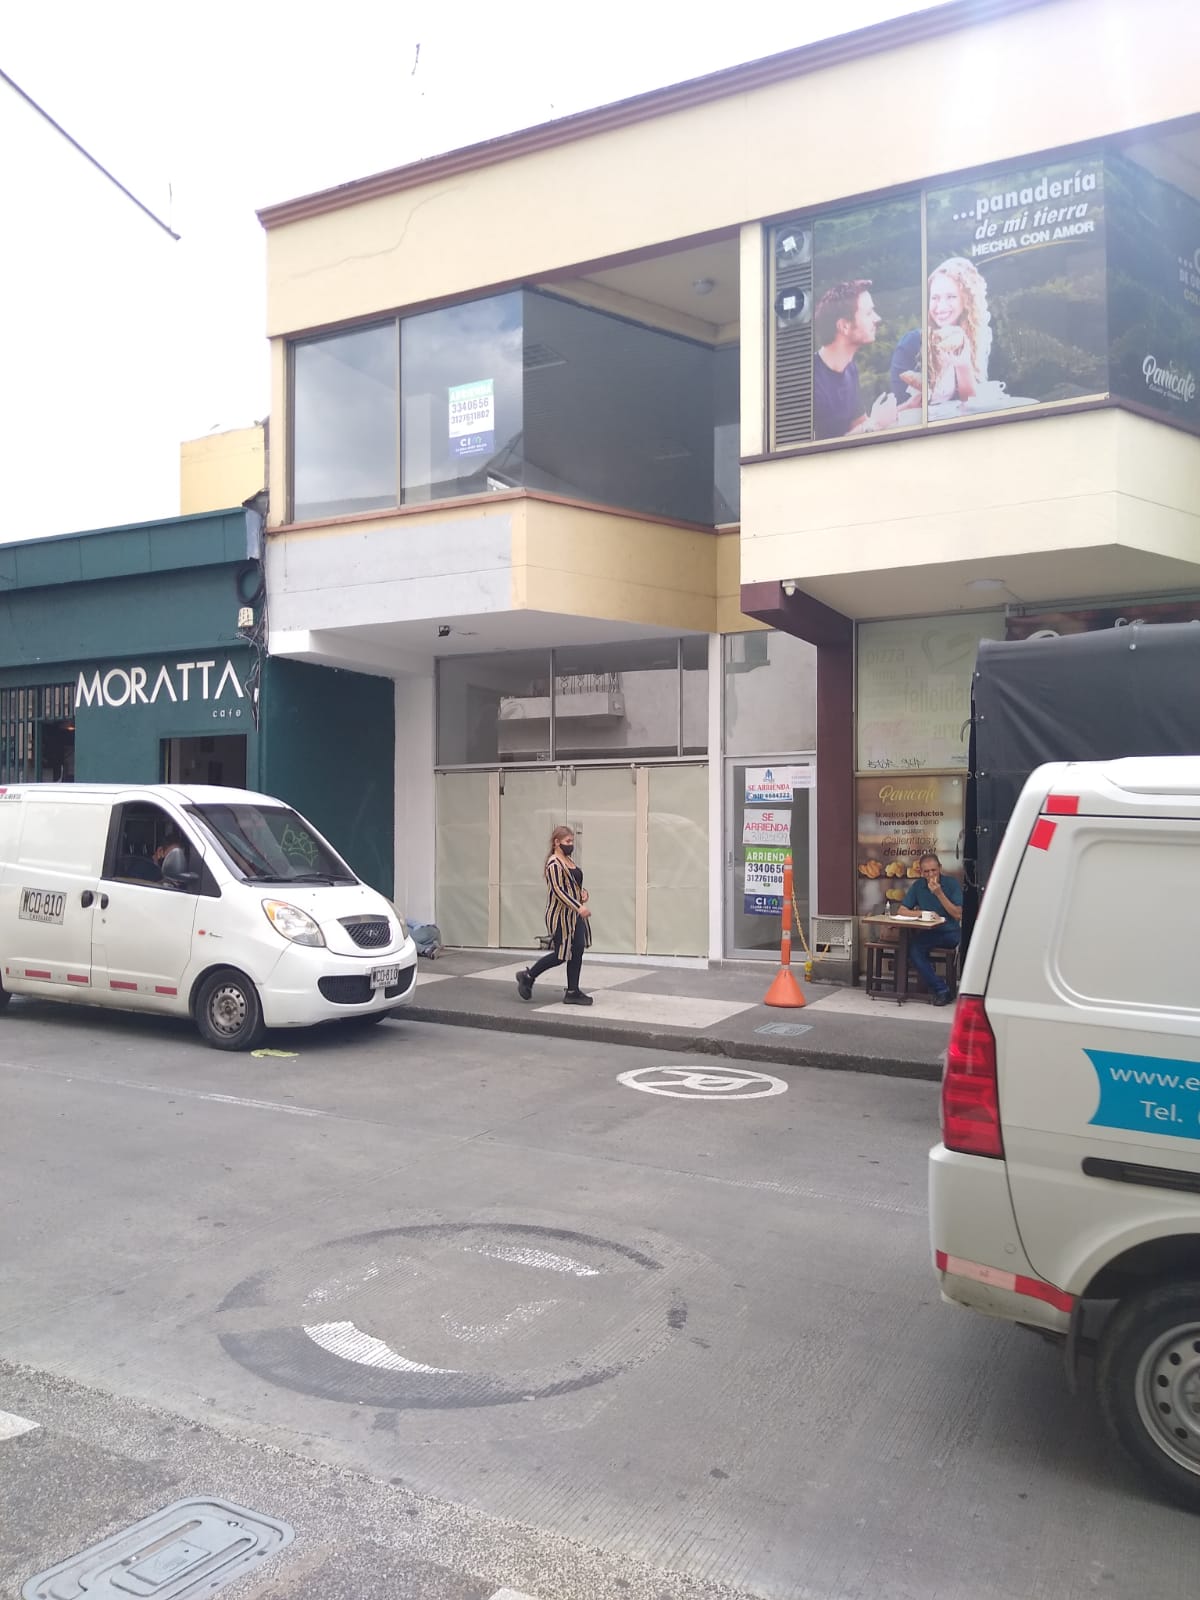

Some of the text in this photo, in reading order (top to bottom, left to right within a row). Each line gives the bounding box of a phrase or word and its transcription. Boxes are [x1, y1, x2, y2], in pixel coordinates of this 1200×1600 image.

[975, 202, 1088, 240] de mi tierra
[972, 220, 1095, 257] HECHA CON AMOR
[75, 659, 244, 708] MORATTA
[762, 812, 774, 822] SE
[905, 809, 944, 819] productos
[744, 822, 789, 832] ARRIENDA
[879, 819, 919, 827] horneados
[746, 851, 790, 862] ARRIEND
[746, 874, 783, 884] 312761180
[1139, 1100, 1184, 1124] Tel.
